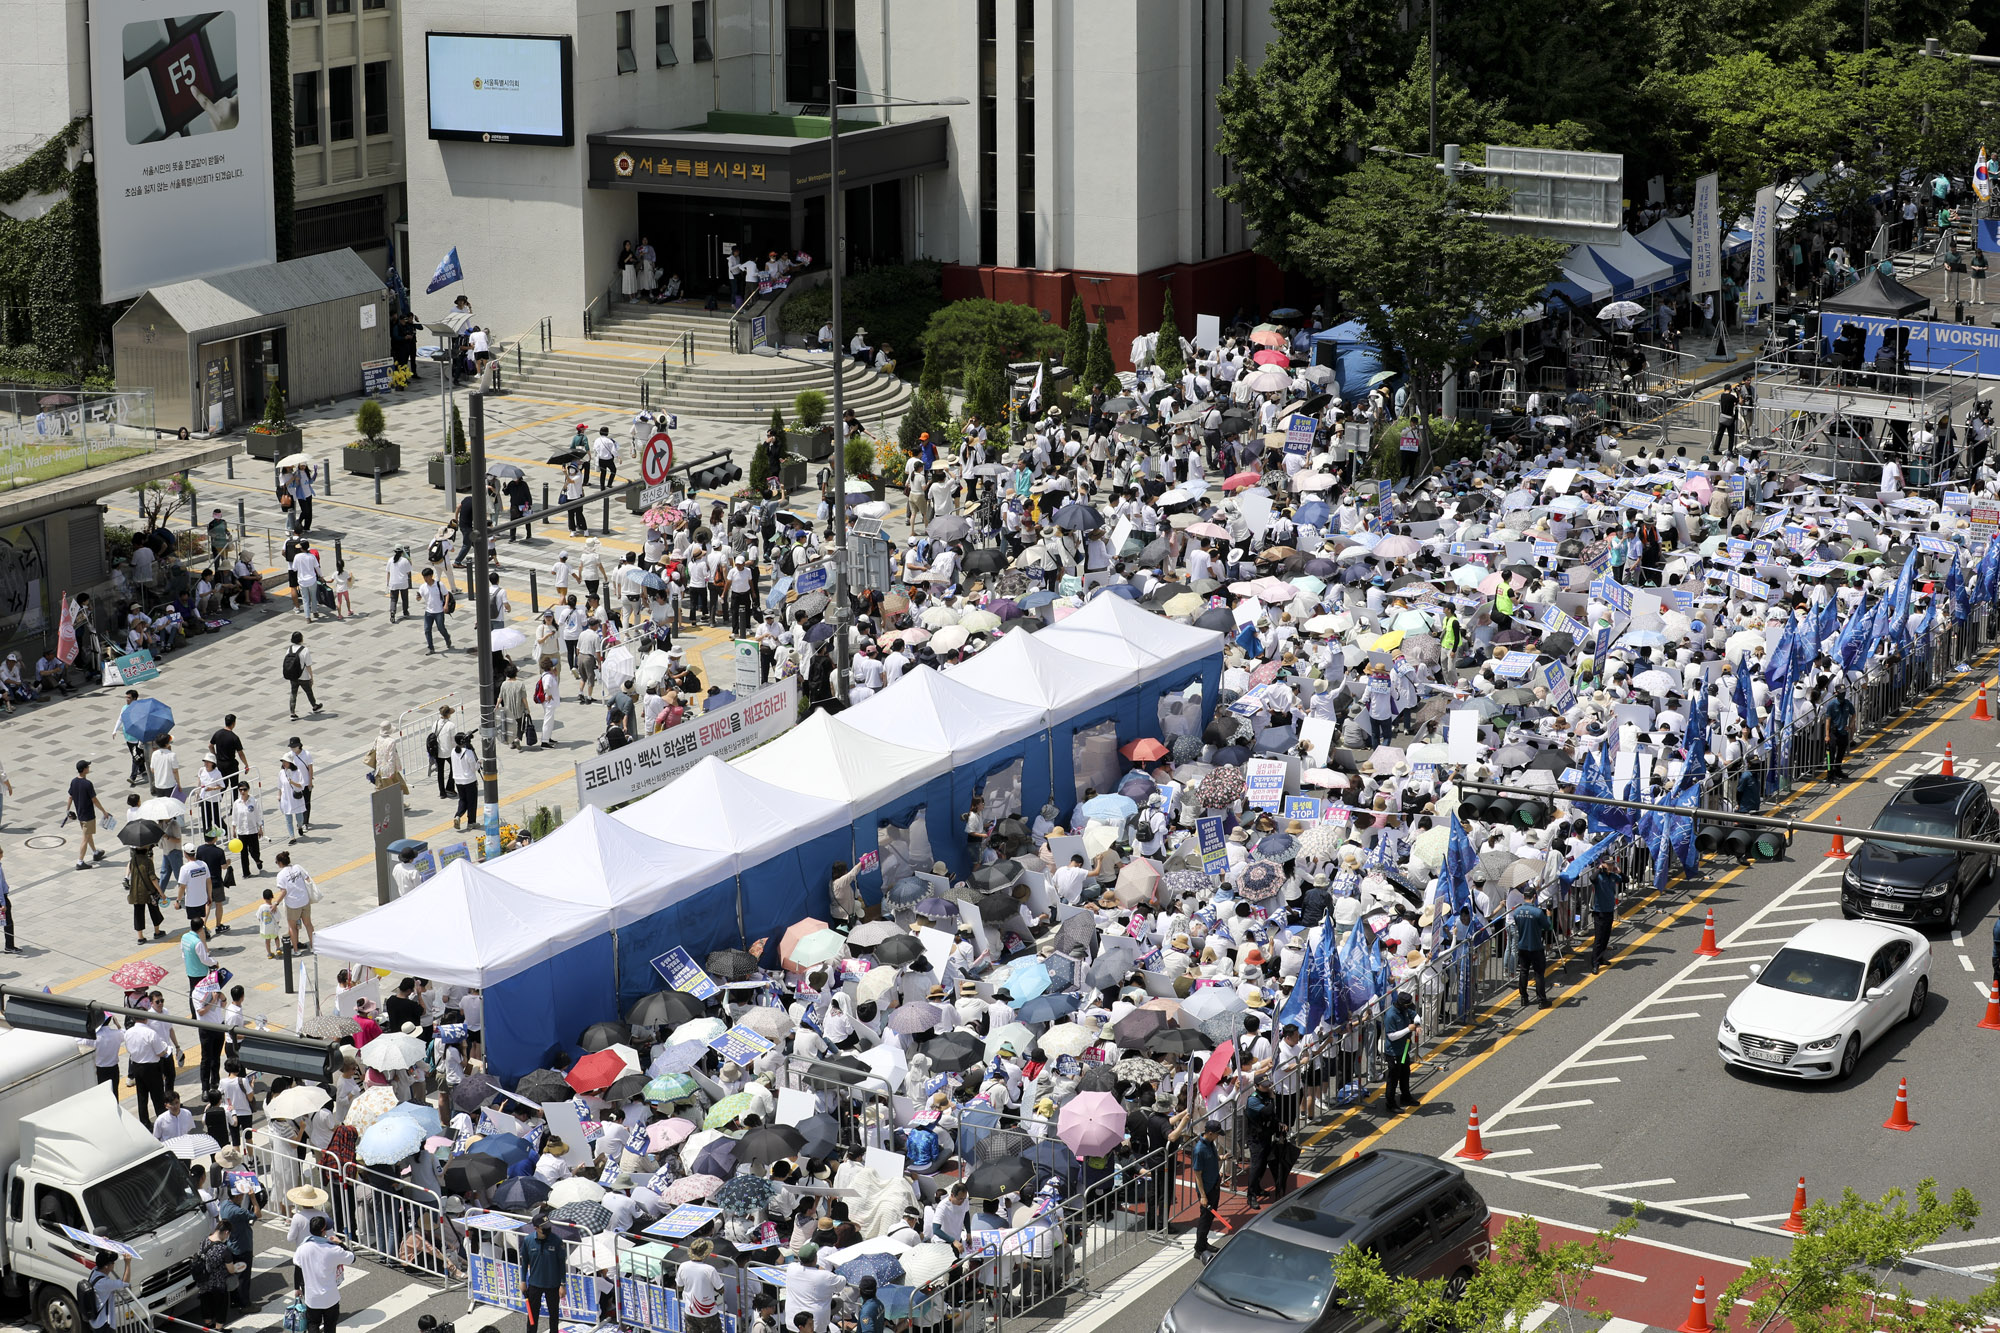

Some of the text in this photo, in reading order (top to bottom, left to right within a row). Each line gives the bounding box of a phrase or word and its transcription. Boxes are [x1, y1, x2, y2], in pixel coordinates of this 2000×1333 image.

[168, 53, 196, 95] F5
[484, 79, 520, 87] 서울특별시의회
[143, 154, 225, 176] 서울시민의 뜻을 한결같이 받들어
[639, 157, 766, 181] 서울특별시의회
[125, 185, 142, 198] 초심을
[144, 183, 155, 194] 잃지
[157, 181, 168, 192] 않는
[170, 175, 214, 189] 서울특별시의회가
[1756, 205, 1768, 283] HOLYKOREA
[642, 482, 670, 503] 적신호시
[663, 731, 697, 759] 학살범
[698, 712, 741, 747] 문재인을
[743, 691, 787, 727] 체포하라!
[1290, 810, 1314, 818] STOP!
[1292, 801, 1312, 810] 동성애
[690, 981, 711, 997] 대반대!
